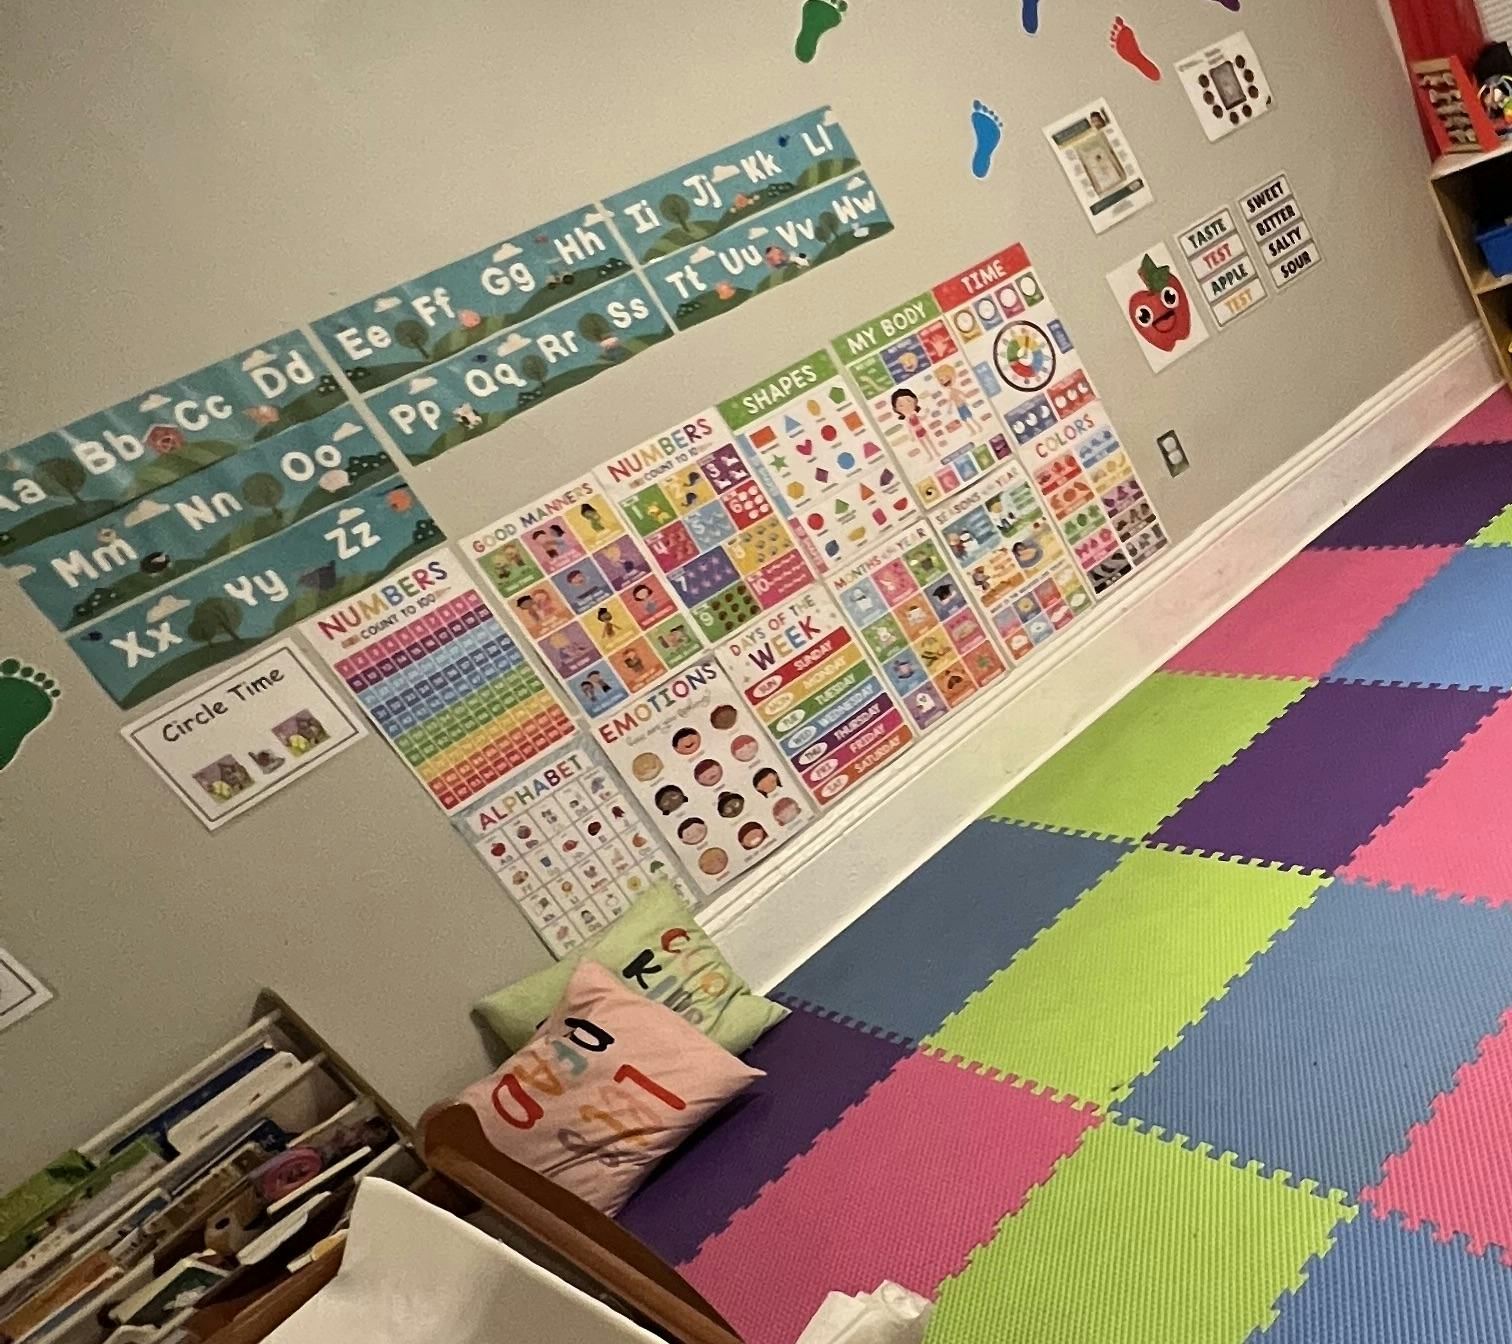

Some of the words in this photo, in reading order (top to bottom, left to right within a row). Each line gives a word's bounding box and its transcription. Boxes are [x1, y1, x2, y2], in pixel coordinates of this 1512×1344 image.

[1246, 181, 1284, 214] SWEET
[1187, 218, 1227, 249] TASTE
[1256, 204, 1296, 236] BITTER
[1202, 243, 1233, 270] TEST
[1268, 226, 1302, 257] SALTY
[960, 259, 1008, 294] TIME
[1211, 263, 1249, 297] APPLE
[1280, 250, 1312, 279] SOUR
[73, 430, 144, 475] Bb
[174, 395, 233, 431] Cc
[251, 349, 314, 399] Dd
[334, 325, 392, 361] Ee
[411, 287, 455, 327] Ff
[481, 261, 536, 296] Gg
[553, 227, 606, 265] Hh
[624, 199, 661, 234] Ii
[683, 174, 722, 208] Jj
[740, 150, 782, 183] Kk
[801, 124, 833, 156] Ll
[1225, 287, 1253, 314] TEST
[846, 327, 878, 355] MY
[880, 301, 927, 337] BODY
[51, 536, 138, 588] Mm
[175, 491, 243, 531] Nn
[280, 444, 342, 482] Oo
[388, 399, 441, 435] Pp
[536, 330, 579, 364] Rr
[607, 298, 650, 328] Ss
[664, 264, 707, 299] Tt
[719, 245, 763, 275] Uu
[775, 218, 816, 248] Vv
[831, 191, 877, 224] Ww
[742, 364, 817, 414] SHAPES
[607, 418, 713, 483] NUMBERS
[1035, 413, 1095, 458] COLORS
[644, 460, 673, 481] COUNT
[675, 453, 689, 466] TO
[705, 464, 721, 478] 3
[472, 523, 517, 553] GOOD
[519, 482, 594, 528] MANNERS
[631, 505, 644, 521] 1
[729, 498, 744, 515] 6
[935, 491, 981, 525] SESONS
[652, 540, 668, 555] 4
[896, 527, 927, 549] YER
[109, 621, 184, 669] Xx
[224, 569, 289, 606] Yy
[324, 522, 381, 559] Zz
[317, 560, 448, 640] NUMBERS
[678, 575, 689, 592] 7
[752, 577, 770, 595] 10
[360, 614, 399, 640] COUNT
[403, 605, 417, 618] TO
[419, 593, 437, 610] 100
[700, 611, 714, 627] 9
[729, 626, 766, 657] DAYS
[767, 611, 787, 631] OF
[788, 594, 816, 617] THE
[748, 615, 820, 671] WEEK
[793, 640, 833, 672] SUNDAY
[802, 655, 846, 689] MONDAY
[814, 673, 857, 705] TUESDAY
[162, 699, 228, 743] Circle
[227, 666, 286, 702] Time
[598, 662, 717, 744] EMOTIONS
[817, 683, 873, 728] WEDNESDAY
[833, 702, 881, 741] THURSDAY
[849, 721, 886, 754] FRIDAY
[853, 734, 901, 774] SATURDAY
[479, 754, 583, 831] ALPHABET
